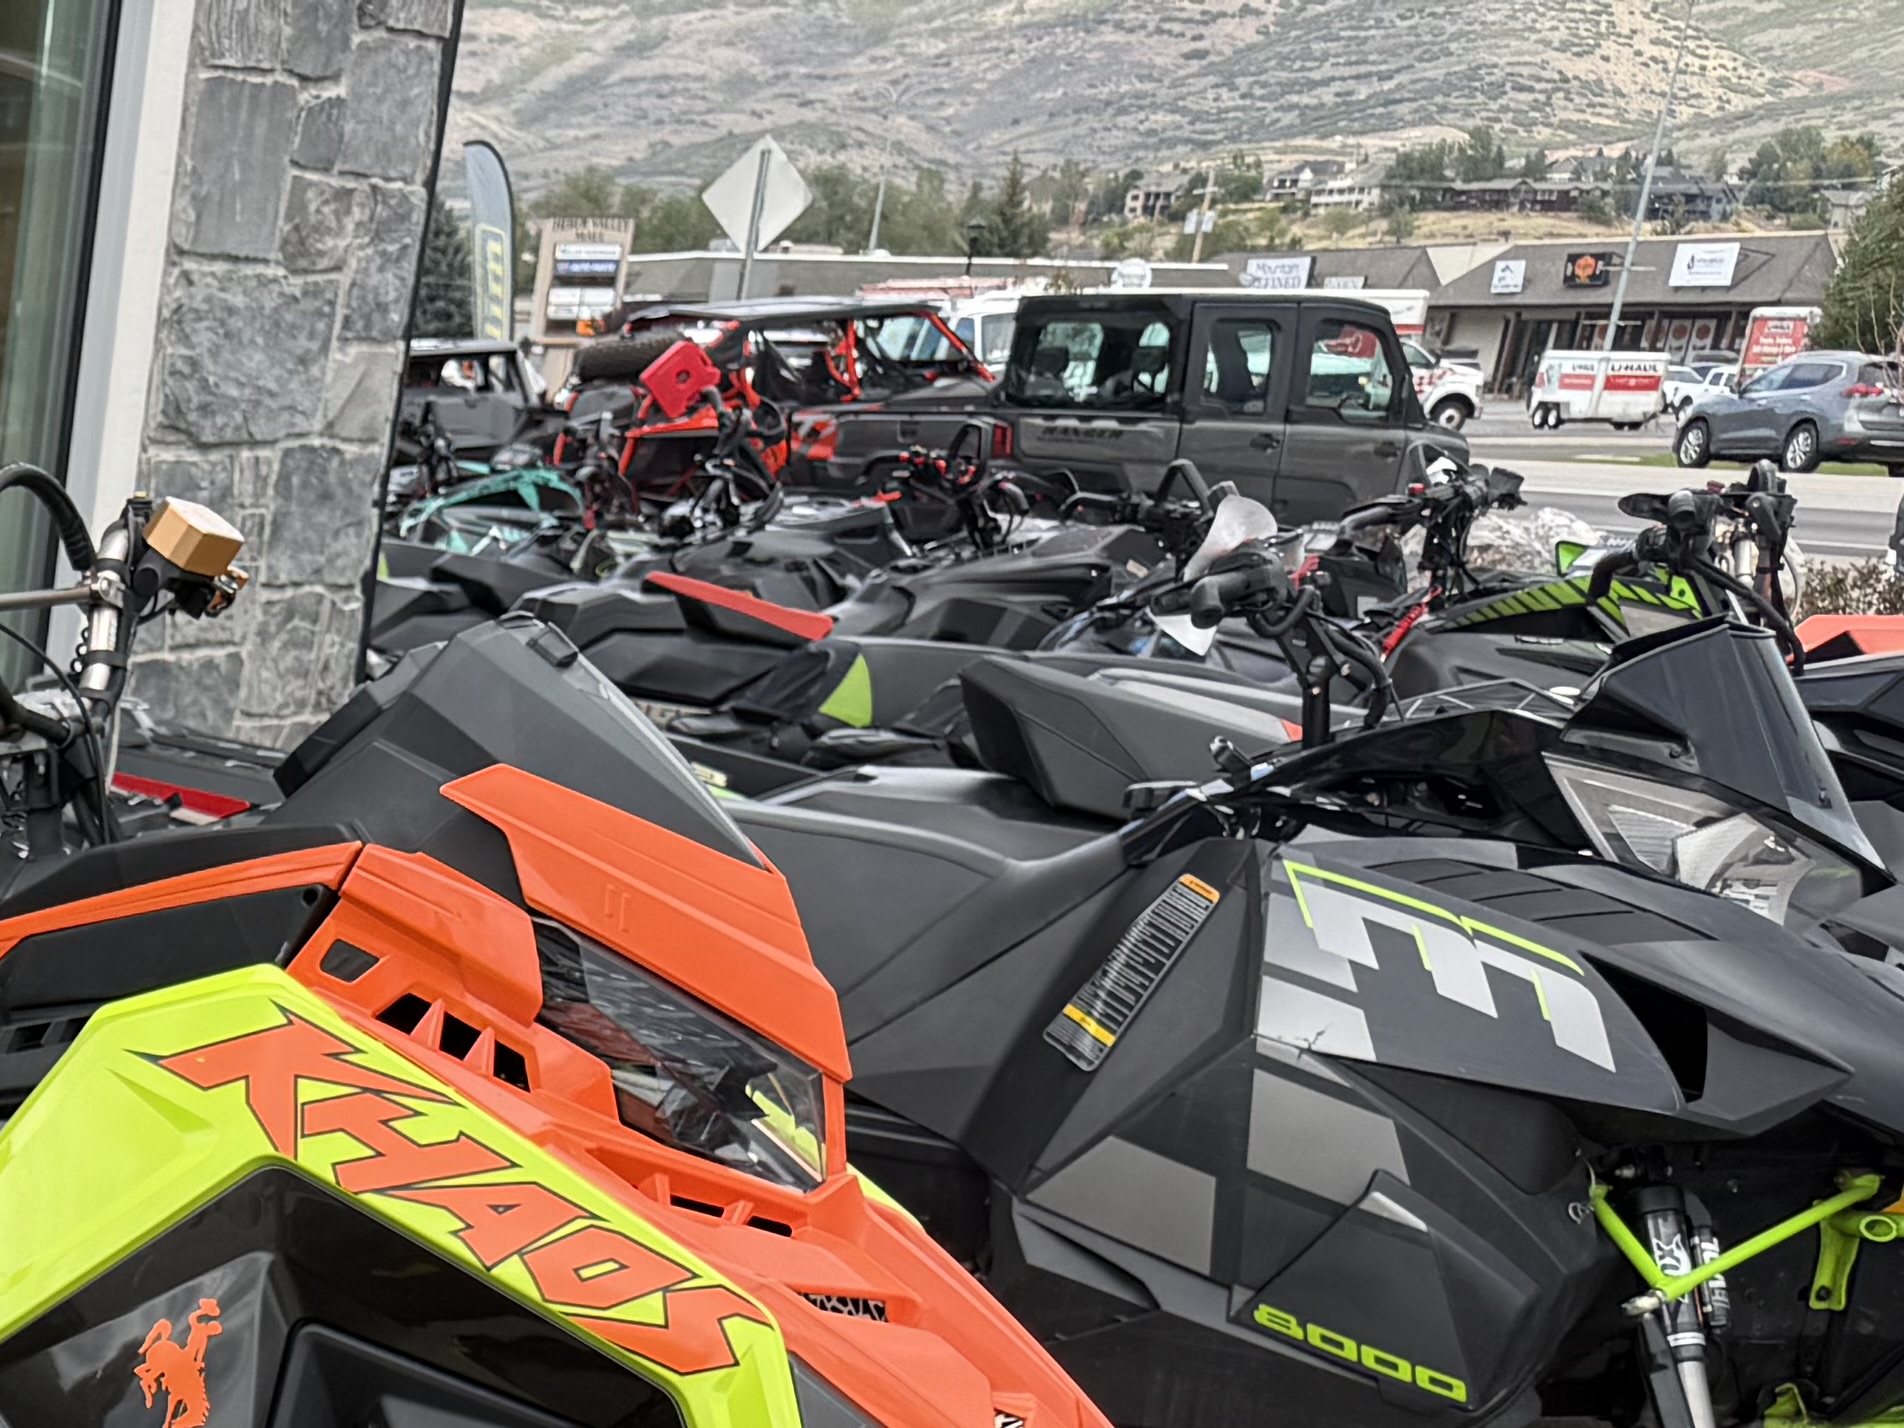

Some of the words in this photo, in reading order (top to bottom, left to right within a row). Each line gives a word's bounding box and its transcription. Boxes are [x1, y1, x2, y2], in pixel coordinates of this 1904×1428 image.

[1611, 363, 1659, 372] U-HAUL
[128, 998, 780, 1375] KHAOS
[1253, 1302, 1467, 1402] 8000
